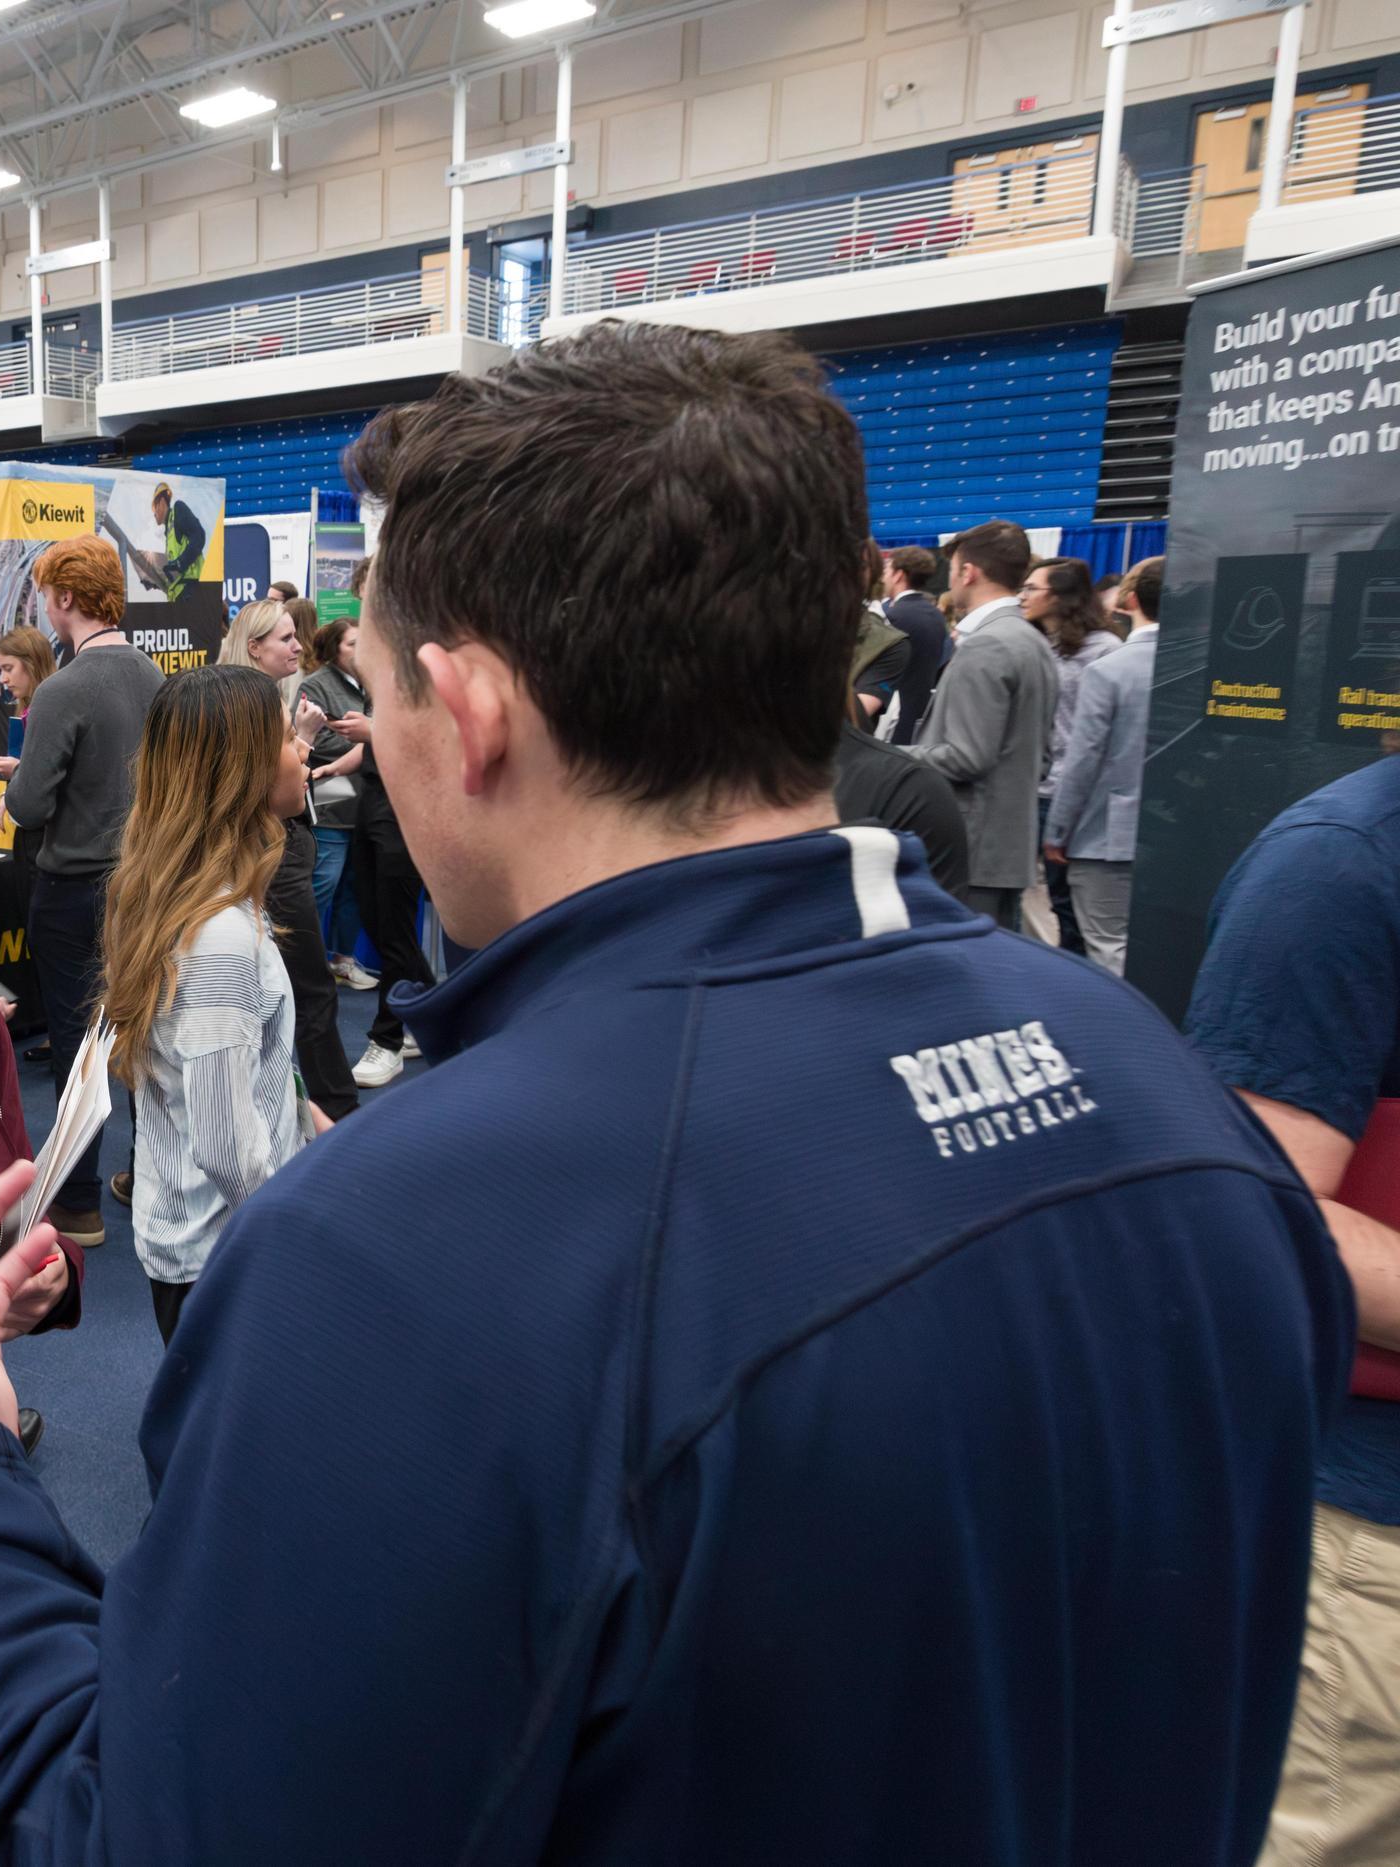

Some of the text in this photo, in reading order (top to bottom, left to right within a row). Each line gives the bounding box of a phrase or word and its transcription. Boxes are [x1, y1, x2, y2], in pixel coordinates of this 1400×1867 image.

[1213, 307, 1287, 354] Build
[1288, 299, 1362, 346] your
[1210, 354, 1269, 394] with
[1273, 357, 1293, 383] a
[1207, 400, 1262, 433] that
[1265, 388, 1354, 425] keeps
[39, 503, 85, 523] Kiewit
[132, 628, 194, 653] PROUD.
[152, 649, 208, 675] KIEWIT
[889, 1020, 1073, 1123] MINES
[931, 1085, 1099, 1158] FOOTBALL
